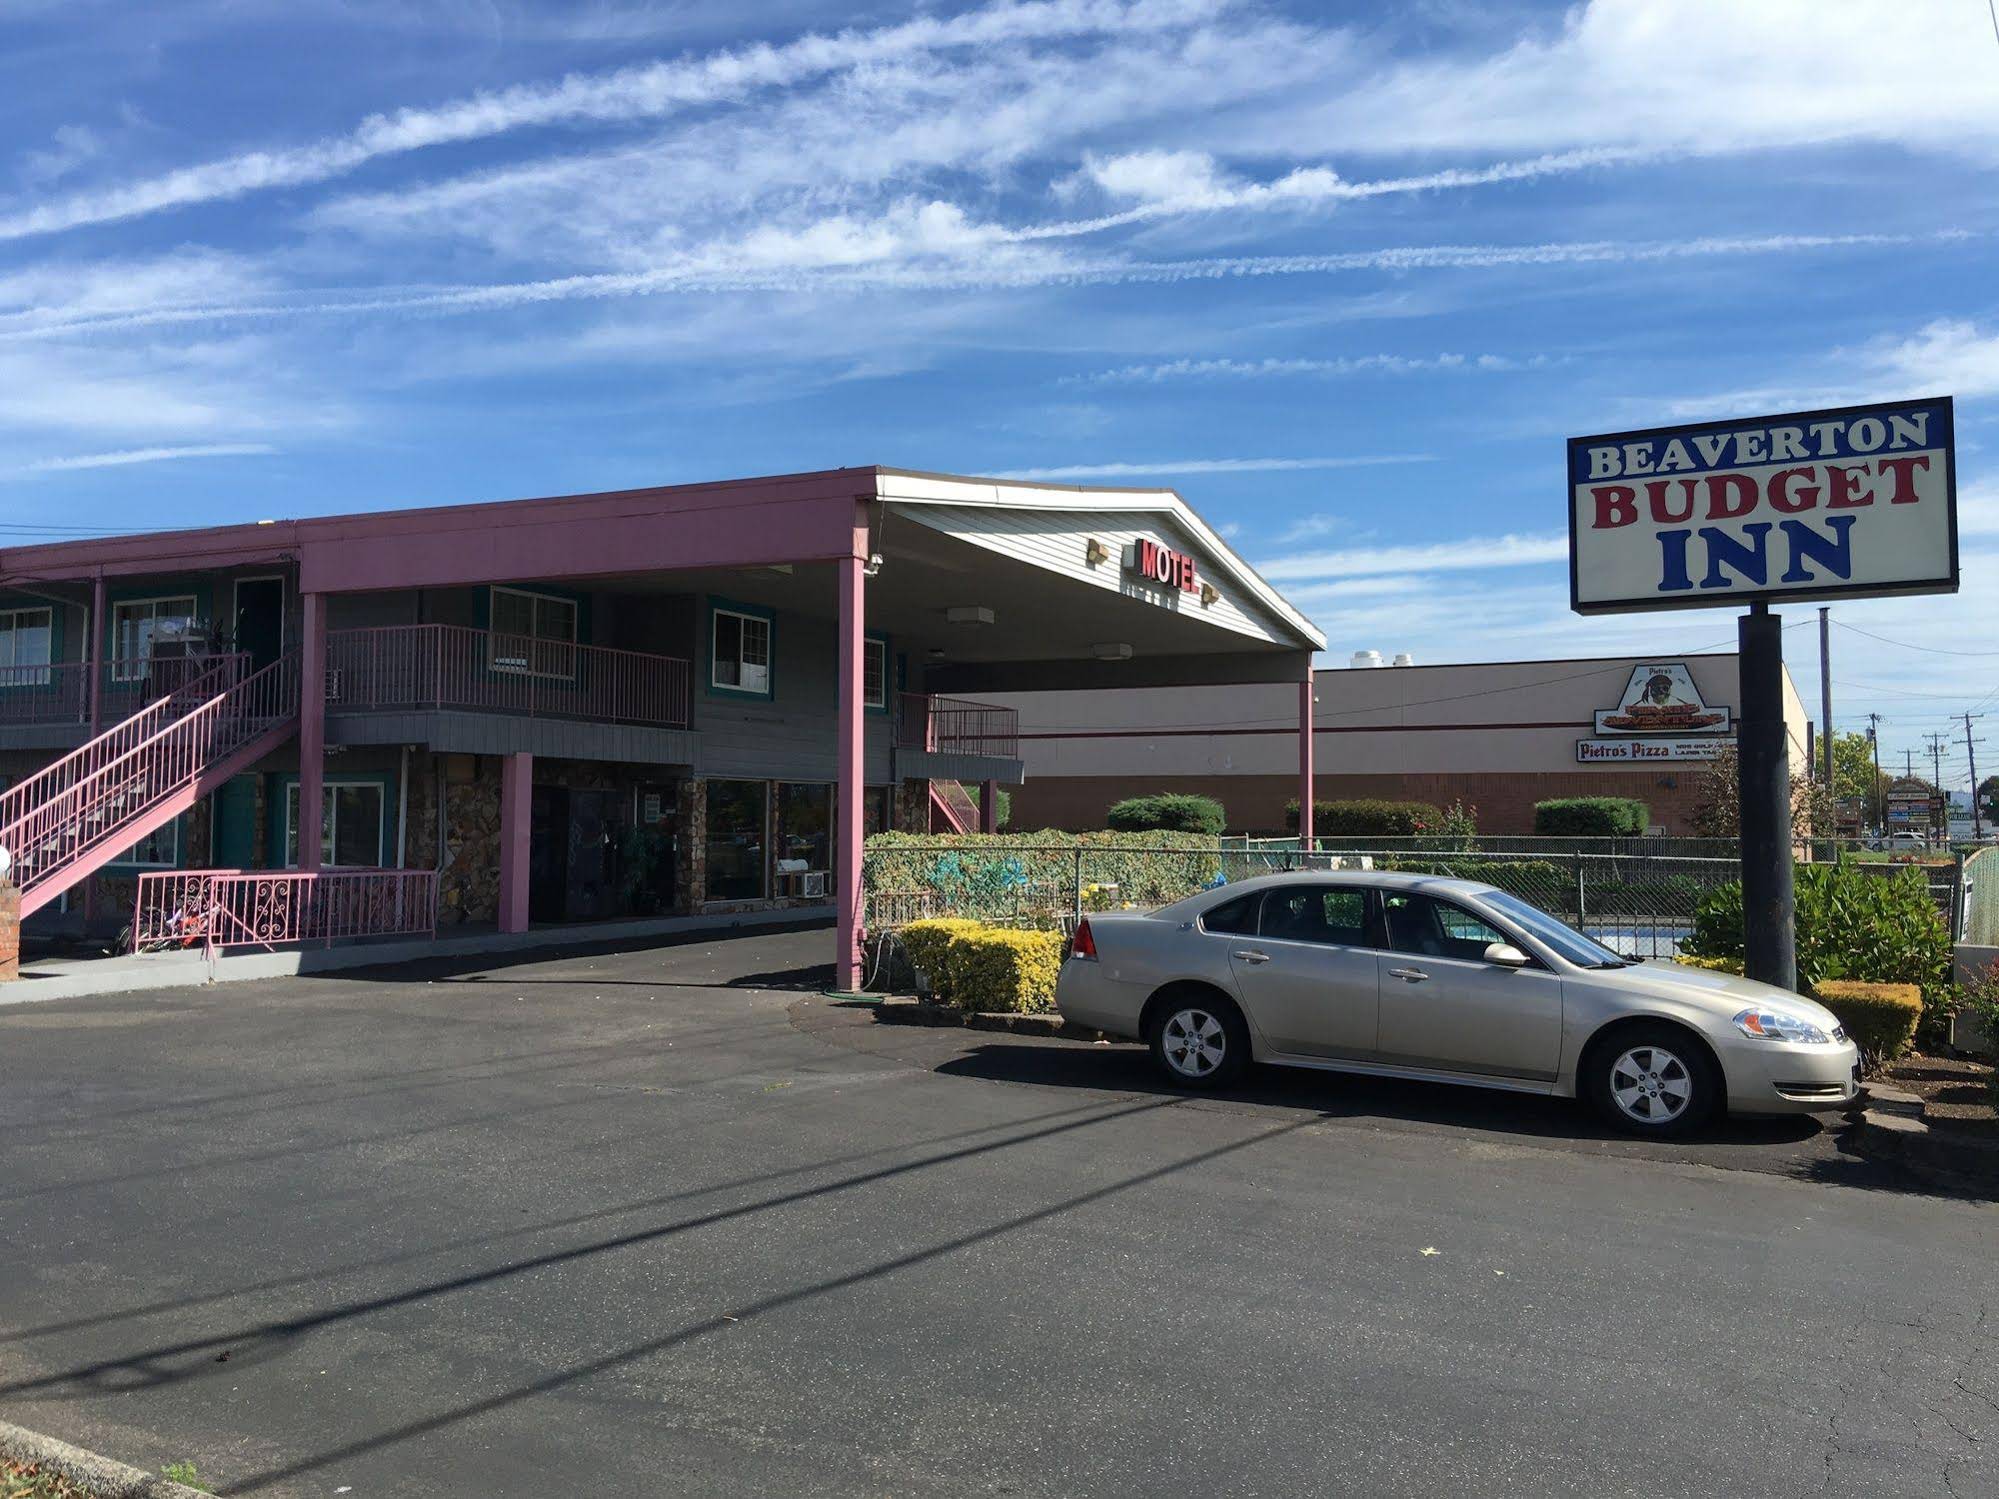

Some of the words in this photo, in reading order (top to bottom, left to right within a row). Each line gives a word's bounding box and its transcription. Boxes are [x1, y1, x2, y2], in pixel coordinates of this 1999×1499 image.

[1588, 412, 1930, 479] BEAVERTON
[1591, 456, 1930, 528] BUDGET
[1142, 539, 1200, 595] MOTEL
[1656, 515, 1856, 591] INN
[1580, 743, 1627, 759] Pietro's
[1631, 742, 1669, 758] Pizza
